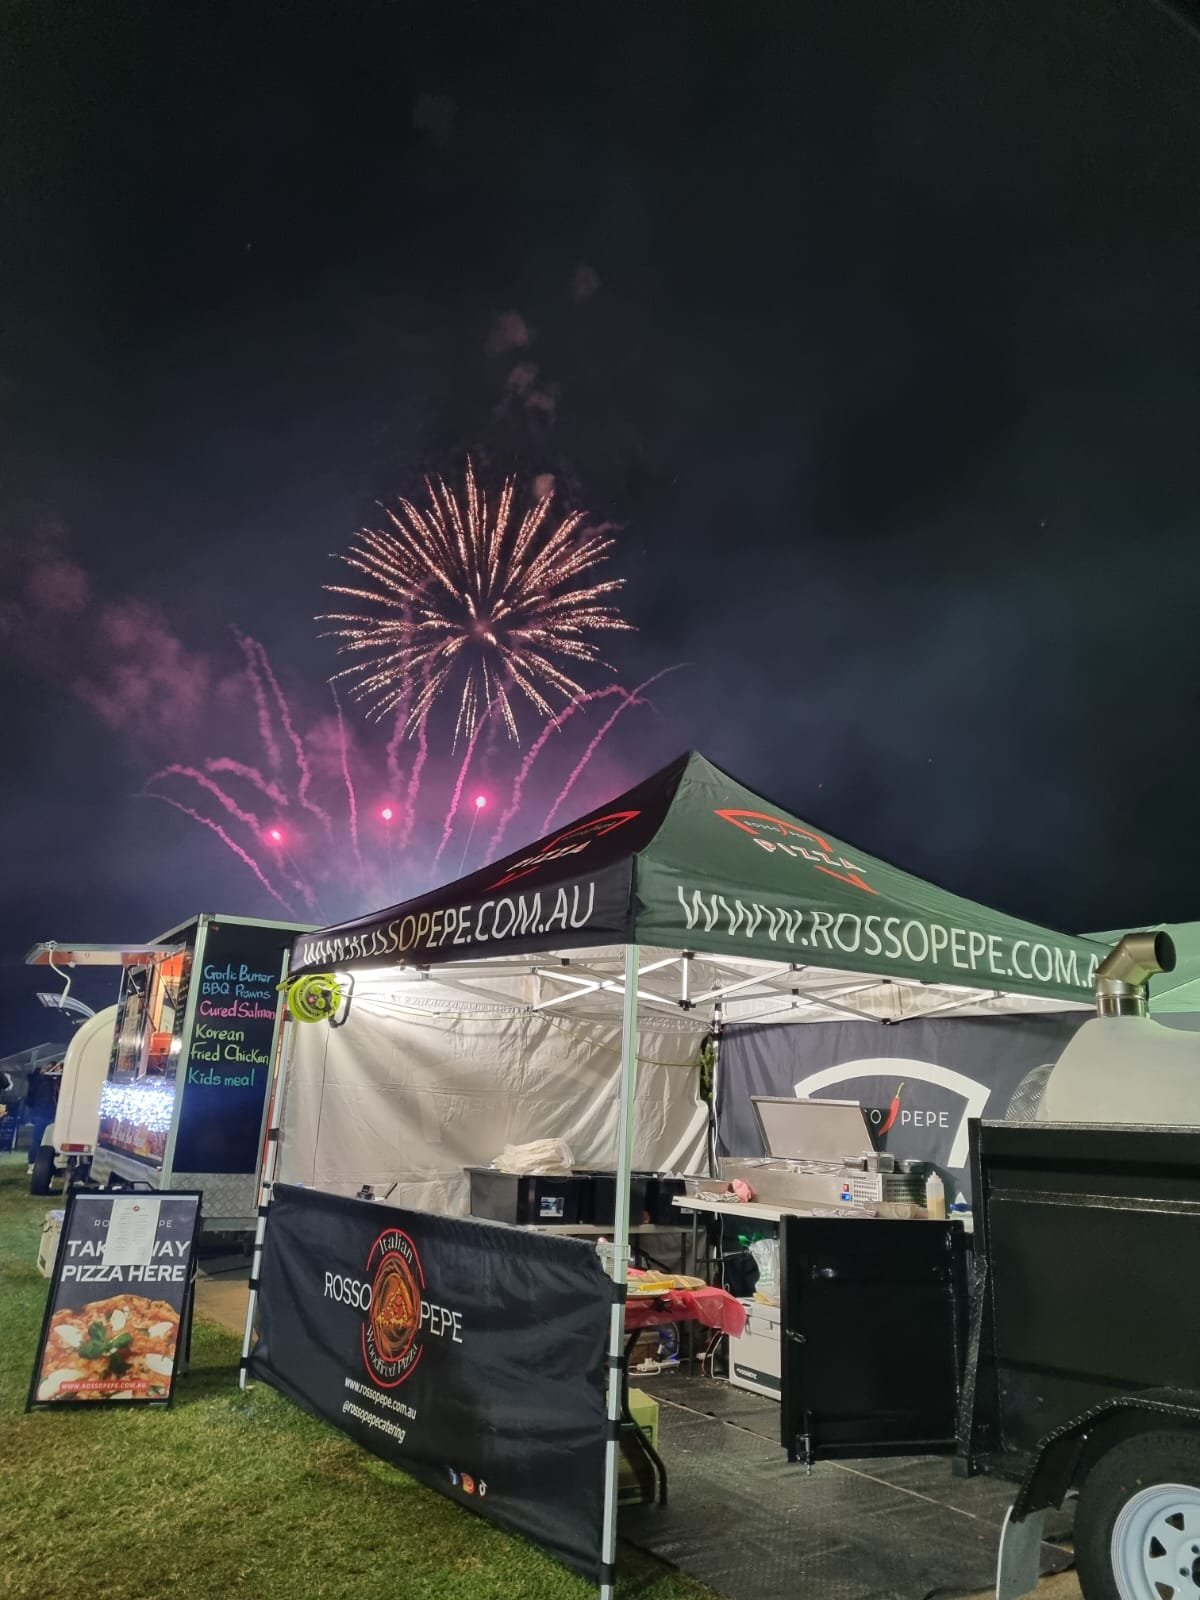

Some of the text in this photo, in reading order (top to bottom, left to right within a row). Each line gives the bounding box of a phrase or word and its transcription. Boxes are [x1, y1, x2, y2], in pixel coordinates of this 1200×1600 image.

[677, 885, 1106, 988] WWW.ROSSOPEPE.COM.A
[203, 963, 275, 983] Garlic Butter
[202, 982, 272, 999] BBQ Prawns
[200, 999, 276, 1020] Cured Salmon
[195, 1023, 245, 1042] Korean
[190, 1041, 220, 1061] Fried
[188, 1067, 255, 1087] Kids meal
[901, 1110, 949, 1128] PEPE
[379, 1232, 413, 1264] Italian
[60, 1265, 186, 1282] PIZZA HERE
[324, 1271, 463, 1344] ROSSO PEPE
[344, 1376, 417, 1421] www.rossopepe.com.au
[342, 1400, 407, 1445] @rossopepecatering
